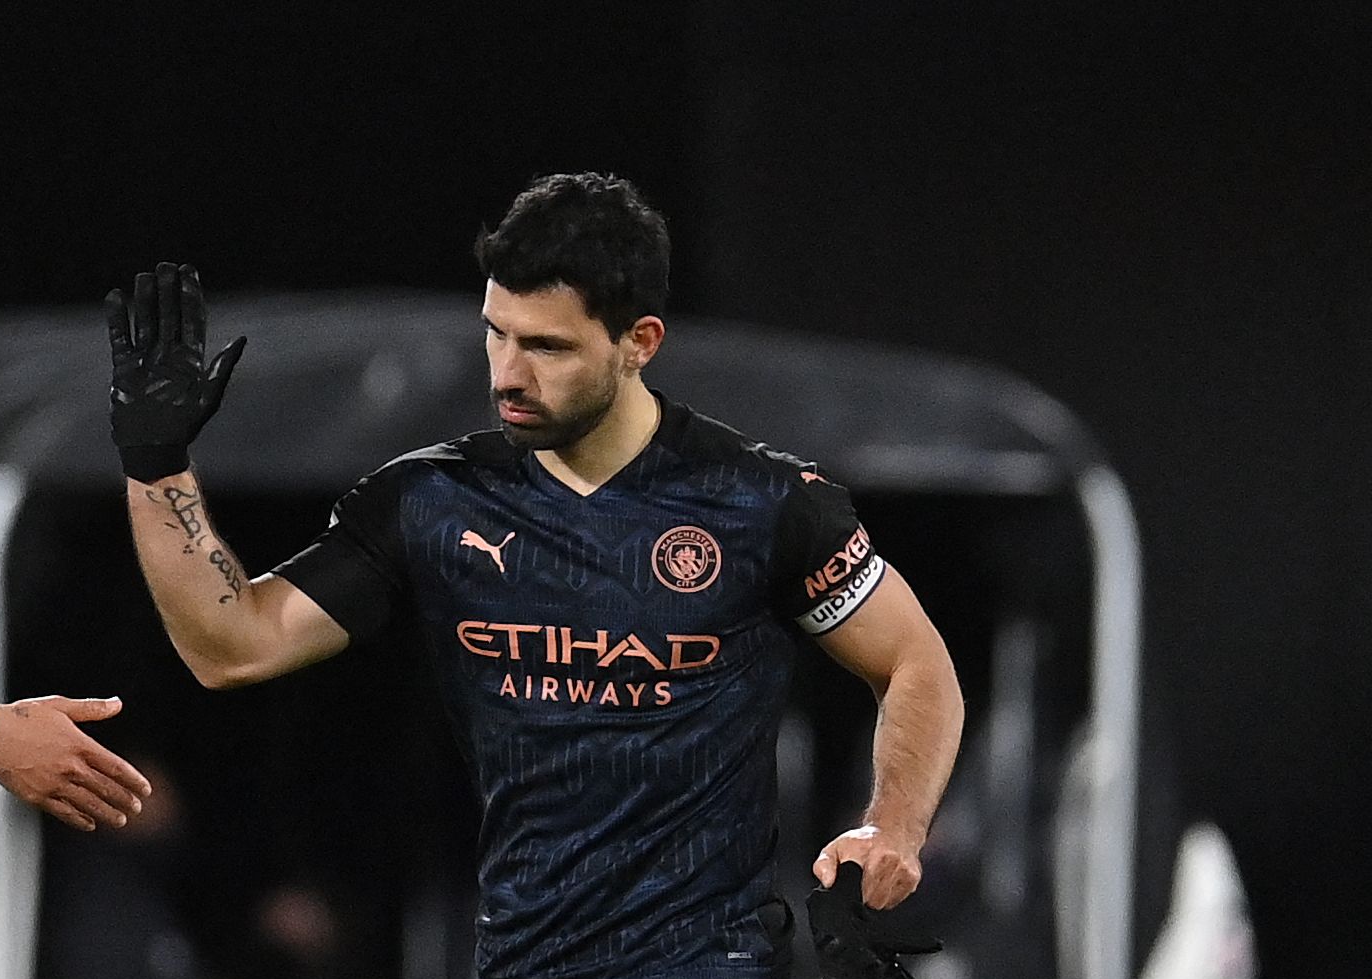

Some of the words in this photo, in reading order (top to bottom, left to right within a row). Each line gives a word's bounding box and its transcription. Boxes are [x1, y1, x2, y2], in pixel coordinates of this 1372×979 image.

[660, 531, 714, 552] MANCHESTER
[456, 620, 720, 670] ETIHAD
[499, 673, 673, 707] AIRWAYS
